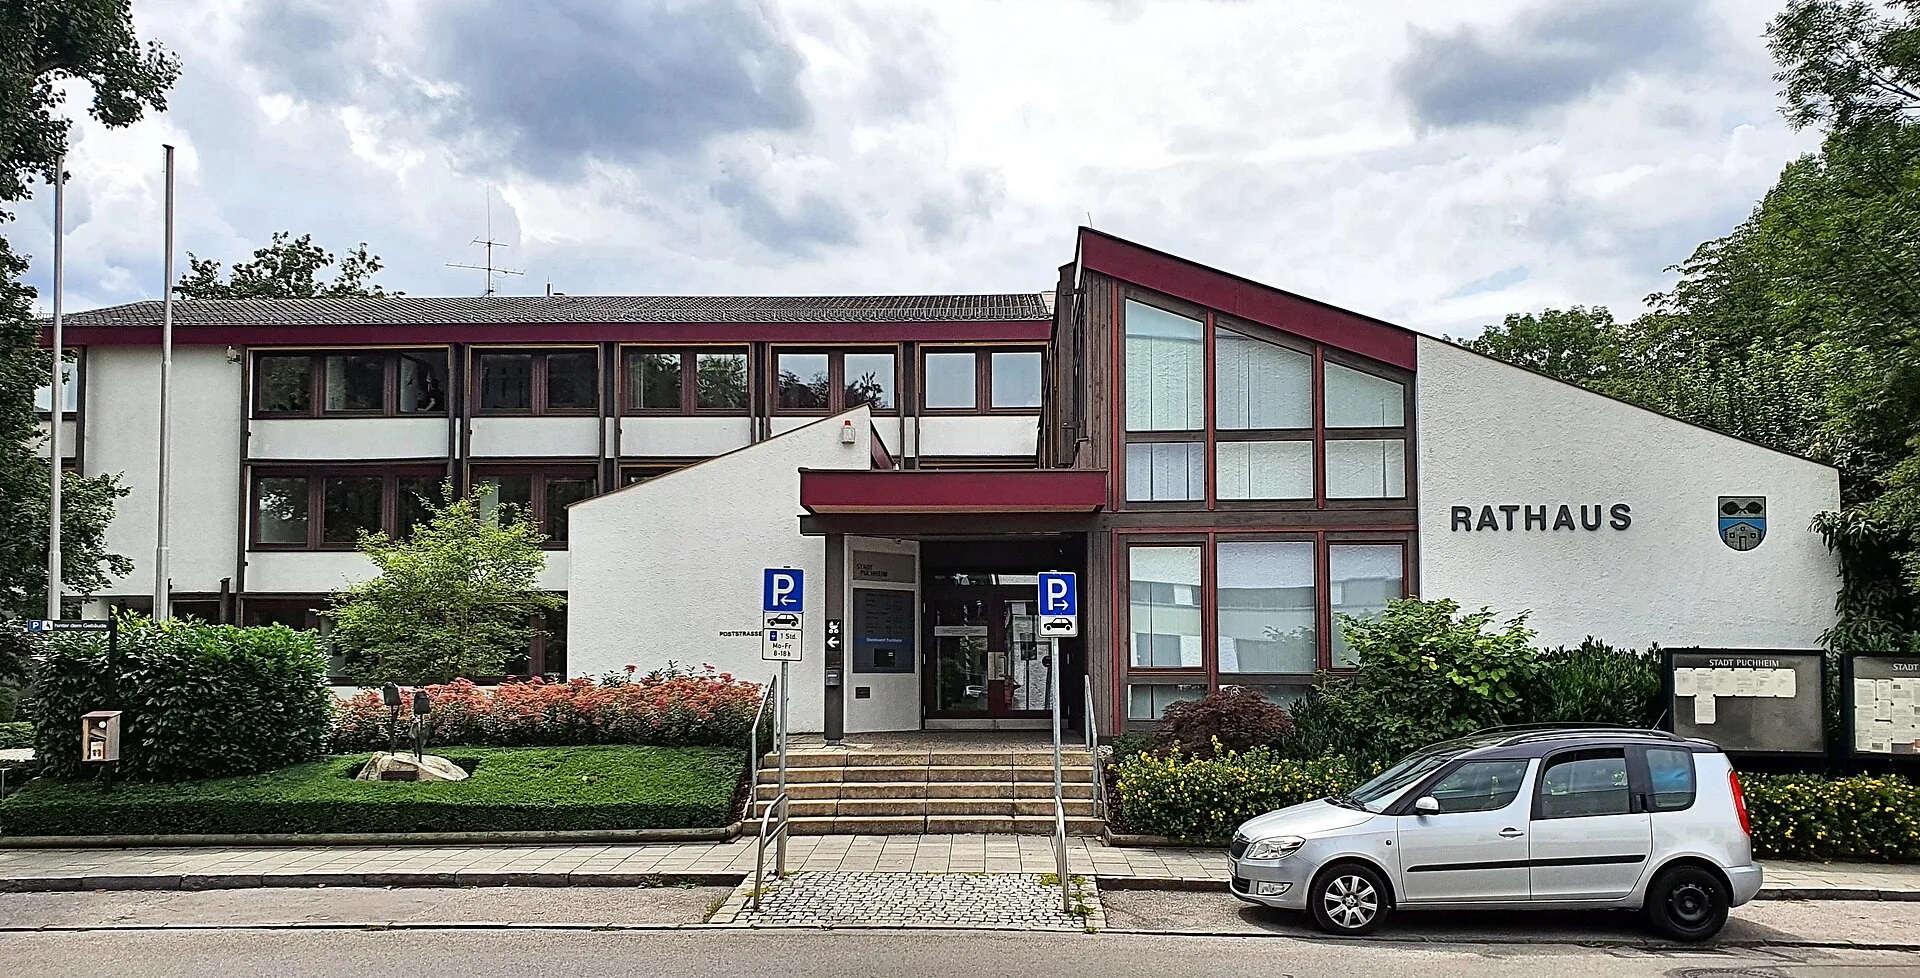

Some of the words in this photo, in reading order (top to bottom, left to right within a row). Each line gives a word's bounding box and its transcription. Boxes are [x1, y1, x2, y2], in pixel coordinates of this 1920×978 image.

[1451, 504, 1632, 531] RATHAUS
[772, 573, 795, 606] P
[1047, 578, 1068, 611] P
[32, 622, 39, 630] P
[785, 632, 798, 640] Std.
[1709, 659, 1734, 667] STADT
[1736, 659, 1780, 667] PUCHHEIM
[1892, 663, 1919, 671] STADT
